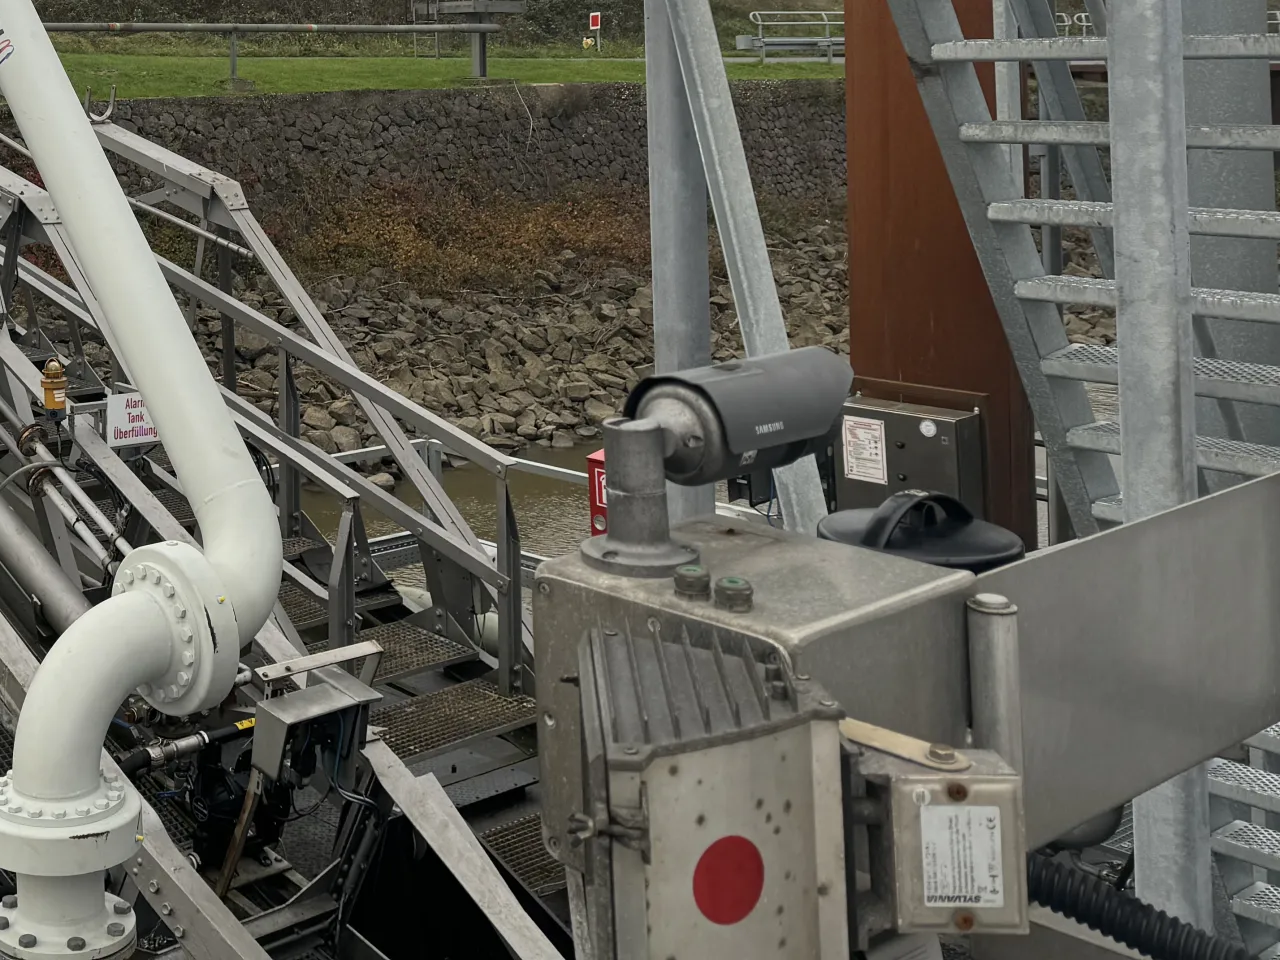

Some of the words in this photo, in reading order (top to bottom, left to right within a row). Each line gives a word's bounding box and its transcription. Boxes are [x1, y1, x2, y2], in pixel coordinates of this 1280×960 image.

[127, 411, 145, 424] Tank
[113, 426, 158, 440] Überfüllung
[755, 421, 784, 435] SAMSUNG
[926, 895, 982, 904] SYLVANIA
